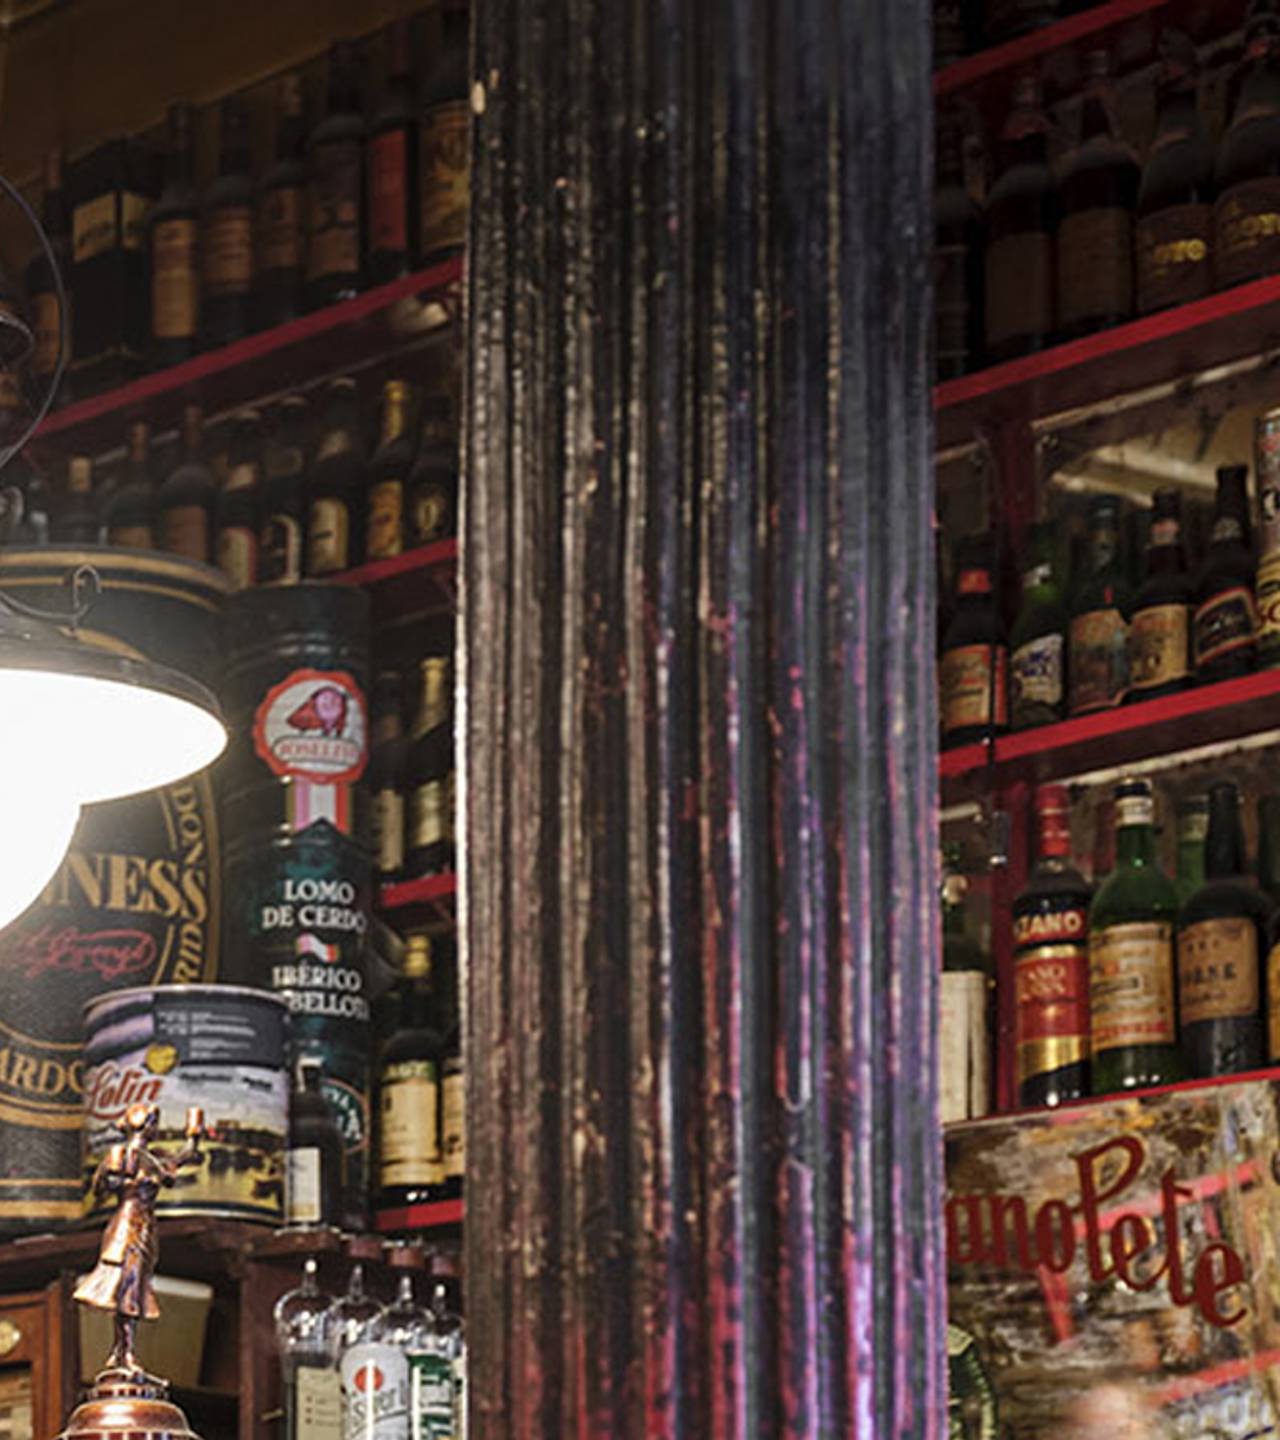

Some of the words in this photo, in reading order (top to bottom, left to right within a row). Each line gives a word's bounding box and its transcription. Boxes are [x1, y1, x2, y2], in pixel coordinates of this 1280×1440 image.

[284, 879, 355, 904] LOMO
[262, 905, 294, 929] DE
[298, 905, 367, 934] CERDO
